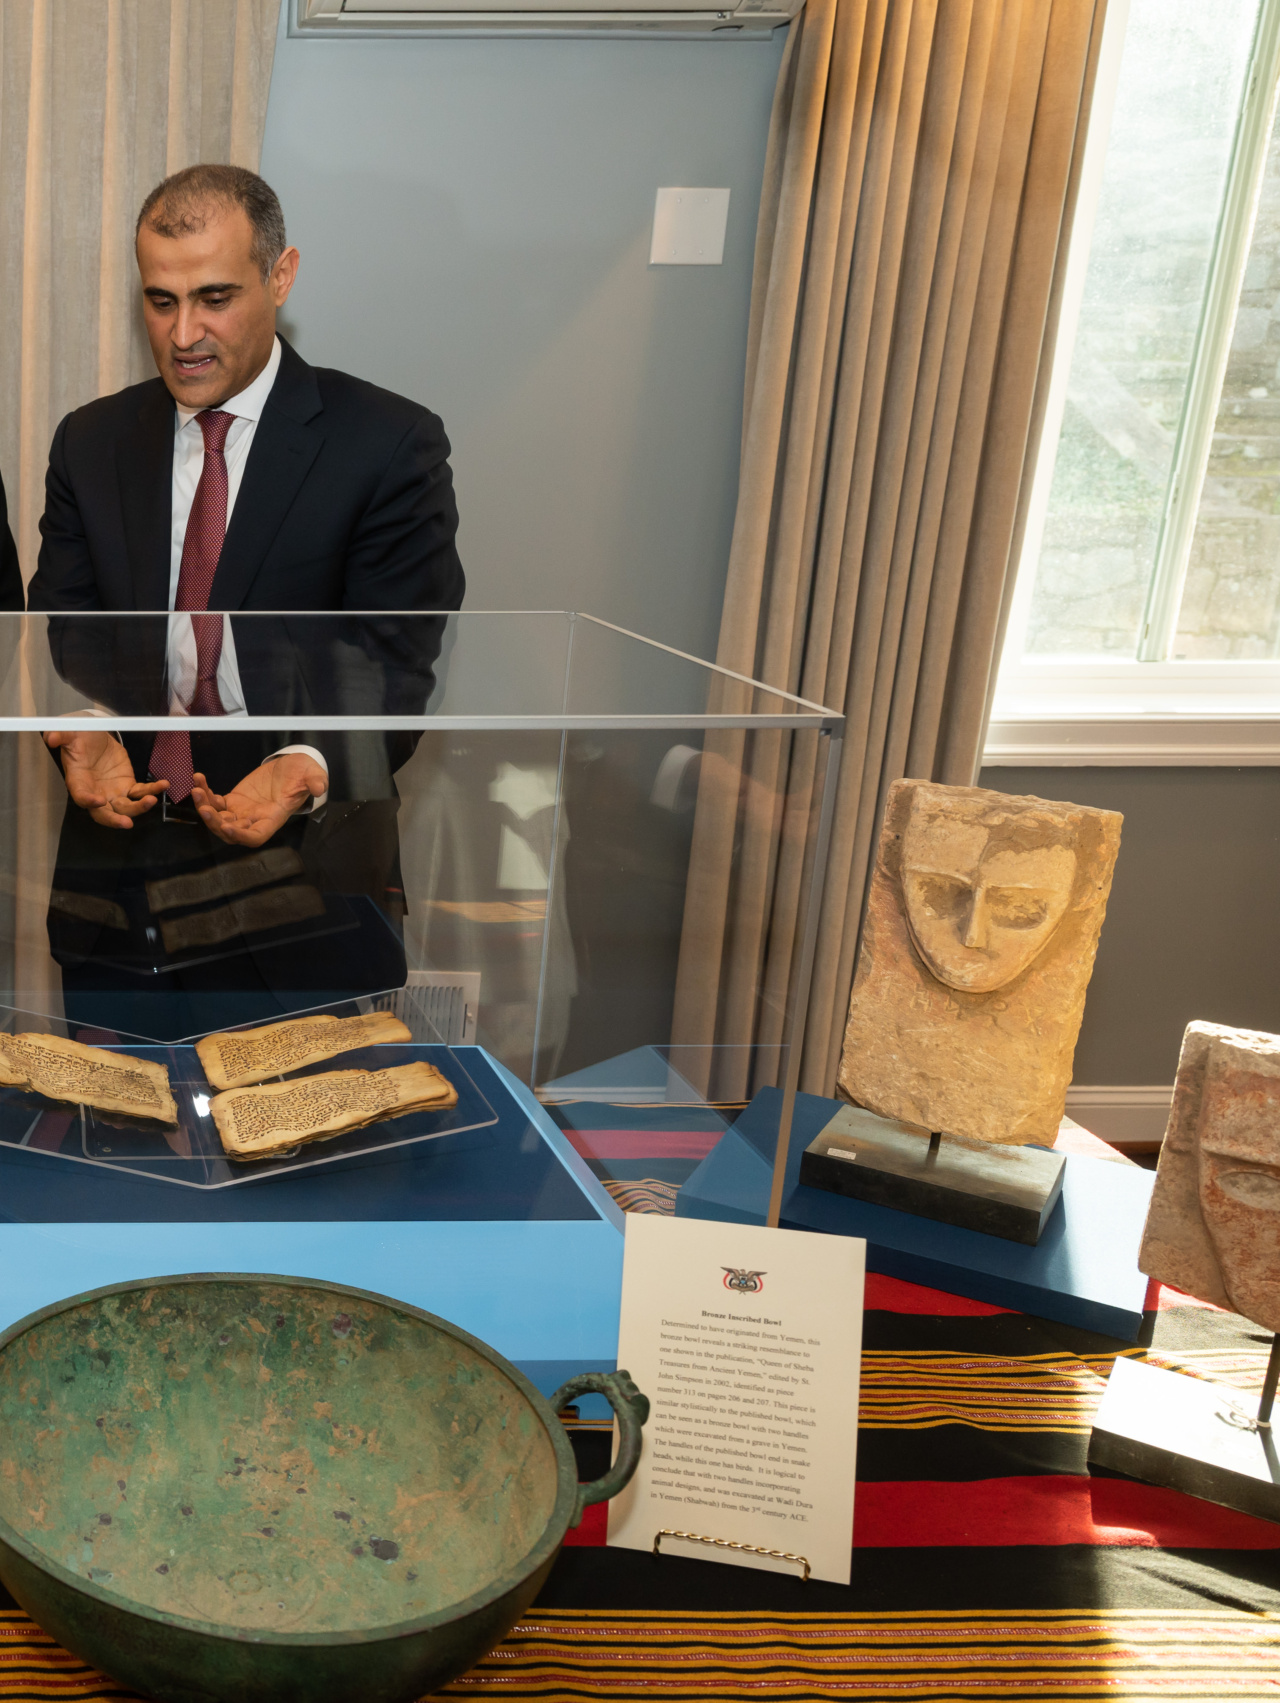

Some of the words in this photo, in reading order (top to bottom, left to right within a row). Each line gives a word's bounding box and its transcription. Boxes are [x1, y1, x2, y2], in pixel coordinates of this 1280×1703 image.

[701, 1310, 726, 1319] Bronze
[728, 1313, 762, 1324] Inscribed
[763, 1318, 782, 1326] Bowl
[661, 1319, 699, 1330] Determined
[709, 1325, 725, 1333] have
[726, 1329, 760, 1338] originated
[762, 1332, 778, 1340] from
[780, 1334, 806, 1344] Yemen,
[658, 1372, 673, 1380] John
[675, 1374, 703, 1383] Simpson
[713, 1379, 732, 1388] 2002,
[734, 1383, 766, 1392] identified
[681, 1403, 717, 1413] stylistically
[740, 1411, 773, 1420] published
[774, 1415, 793, 1424] bowl,
[795, 1419, 816, 1427] which
[774, 1401, 788, 1409] This
[694, 1432, 727, 1441] excavated
[729, 1435, 744, 1443] from
[781, 1443, 807, 1453] Yemen.
[675, 1482, 701, 1492] designs,
[732, 1492, 766, 1501] excavated
[776, 1497, 794, 1506] Wadi
[796, 1500, 813, 1509] Dura
[659, 1493, 682, 1502] Yemen
[684, 1497, 720, 1508] (Shabwah)
[721, 1502, 737, 1510] from
[762, 1510, 787, 1520] century
[790, 1513, 810, 1522] ACE.
